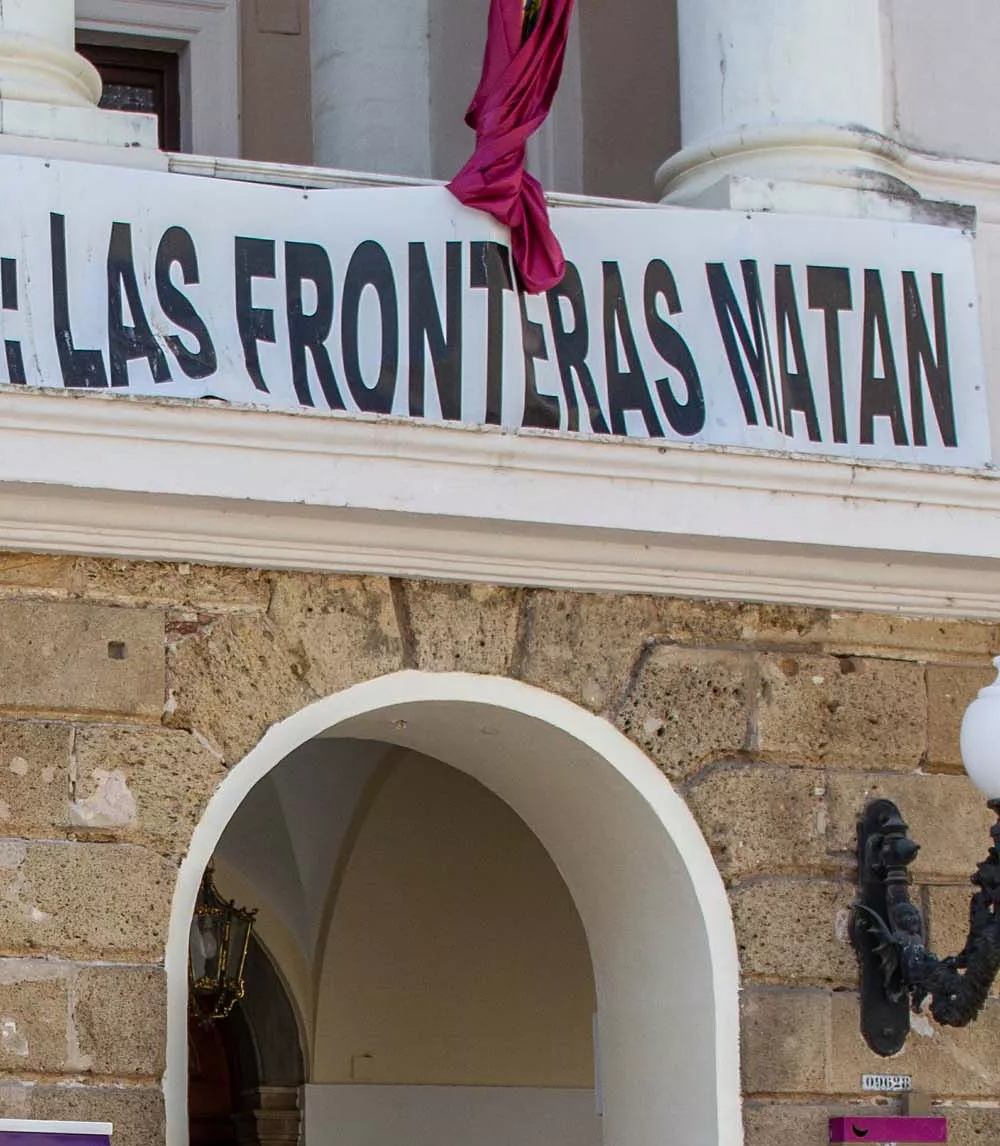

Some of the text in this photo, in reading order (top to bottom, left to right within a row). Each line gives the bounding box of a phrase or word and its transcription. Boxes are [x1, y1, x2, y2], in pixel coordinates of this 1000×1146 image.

[50, 212, 218, 388] LAS
[234, 236, 706, 438] FRONTERAS
[706, 258, 959, 448] MATAN
[865, 1077, 911, 1089] 09628
